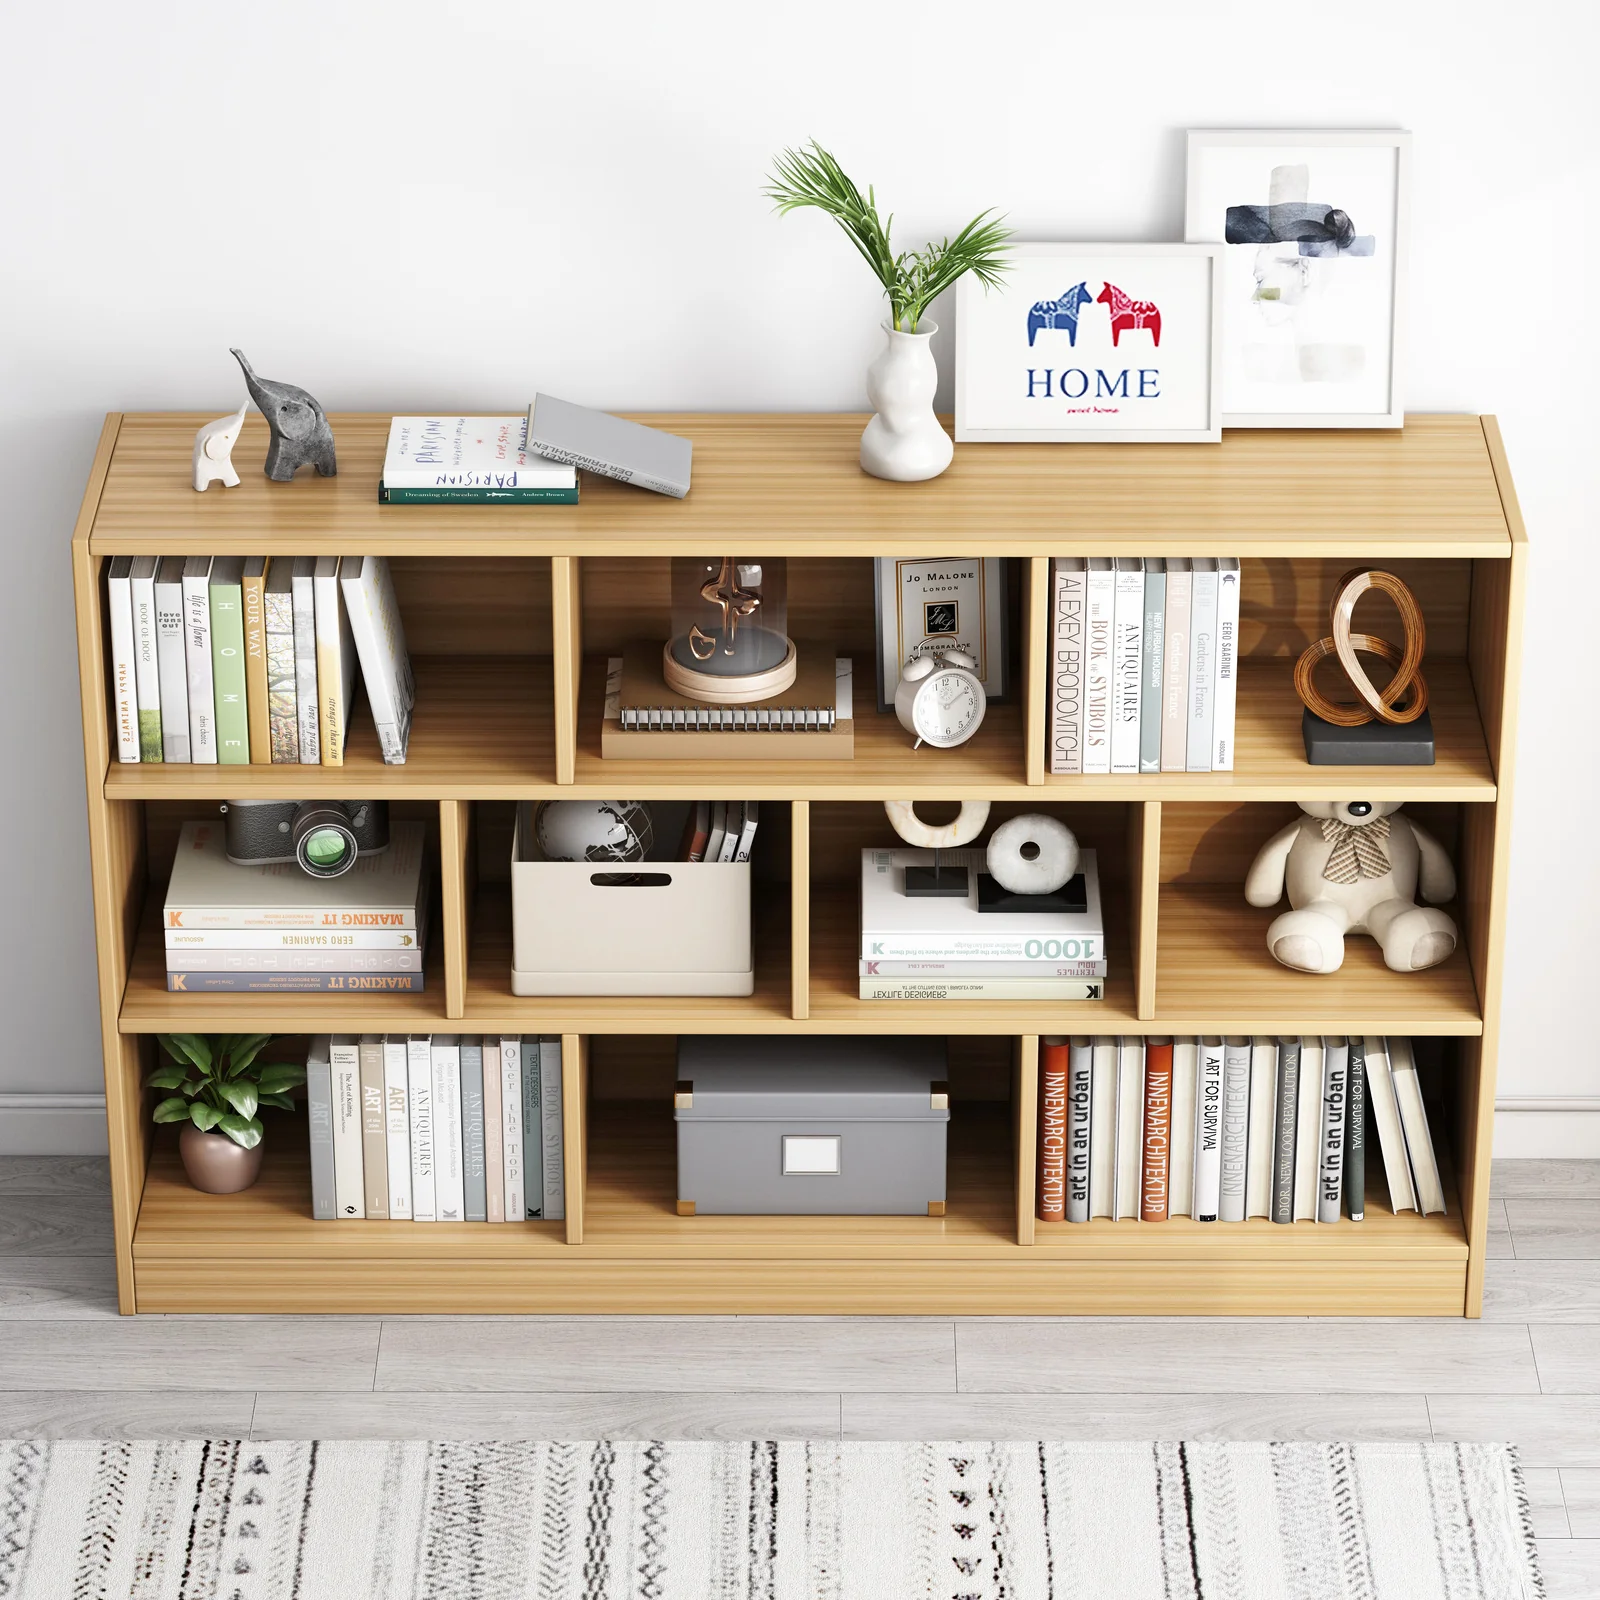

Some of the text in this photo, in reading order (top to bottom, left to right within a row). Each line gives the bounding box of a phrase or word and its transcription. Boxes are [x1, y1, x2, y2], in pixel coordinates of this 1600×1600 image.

[1026, 368, 1161, 398] HOME
[412, 420, 447, 463] PARISIAN
[533, 441, 633, 477] DER PRIMZAHLEN
[540, 451, 630, 482] DIE EINSAMKEIT
[436, 471, 517, 488] PARISIAN
[187, 594, 206, 607] life
[246, 585, 261, 659] YOUR WAY
[1091, 603, 1100, 616] THE
[188, 623, 207, 648] flower
[1090, 620, 1108, 660] BOOK
[1151, 612, 1162, 688] NEW URBAN HOUSING
[1220, 621, 1233, 679] EERO SAARINEN
[218, 602, 241, 747] HOME
[1055, 577, 1082, 762] ALEXEY BRODOVITCH
[1120, 623, 1140, 722] ANTIQUAIRES
[1169, 632, 1185, 719] Gardens in France
[1195, 632, 1210, 719] Gardens in France
[326, 697, 340, 759] stronger than sin
[1088, 676, 1107, 746] SYMBOLS
[282, 935, 354, 945] EERO SAARINEN
[322, 913, 404, 925] MAKING IT
[1025, 939, 1095, 959] 1000
[328, 977, 412, 989] MAKING IT
[1057, 968, 1096, 976] TEXTILES
[364, 1085, 382, 1114] ART
[389, 1086, 405, 1114] ART
[530, 1053, 539, 1108] TEXTILE DESIGNERS
[545, 1085, 559, 1121] BOOK
[1203, 1056, 1220, 1151] ART FOR SURVIVAL
[1352, 1056, 1362, 1150] ART FOR SURVIVAL
[416, 1087, 431, 1176] ANTIQUAIRES
[468, 1091, 484, 1177] ANTIQUAIRES
[1043, 1071, 1066, 1213] INNENARCHITEKTUR
[1068, 1069, 1089, 1201] art in an urban
[1145, 1071, 1169, 1213] INNENARCHITEKTUR
[1222, 1057, 1247, 1197] INNENARCHITEKTUR
[1279, 1054, 1296, 1216] DIOR. NEW LOOK REVOLUTION
[1321, 1070, 1344, 1201] art in an urban
[546, 1134, 560, 1196] SYMBOLS
